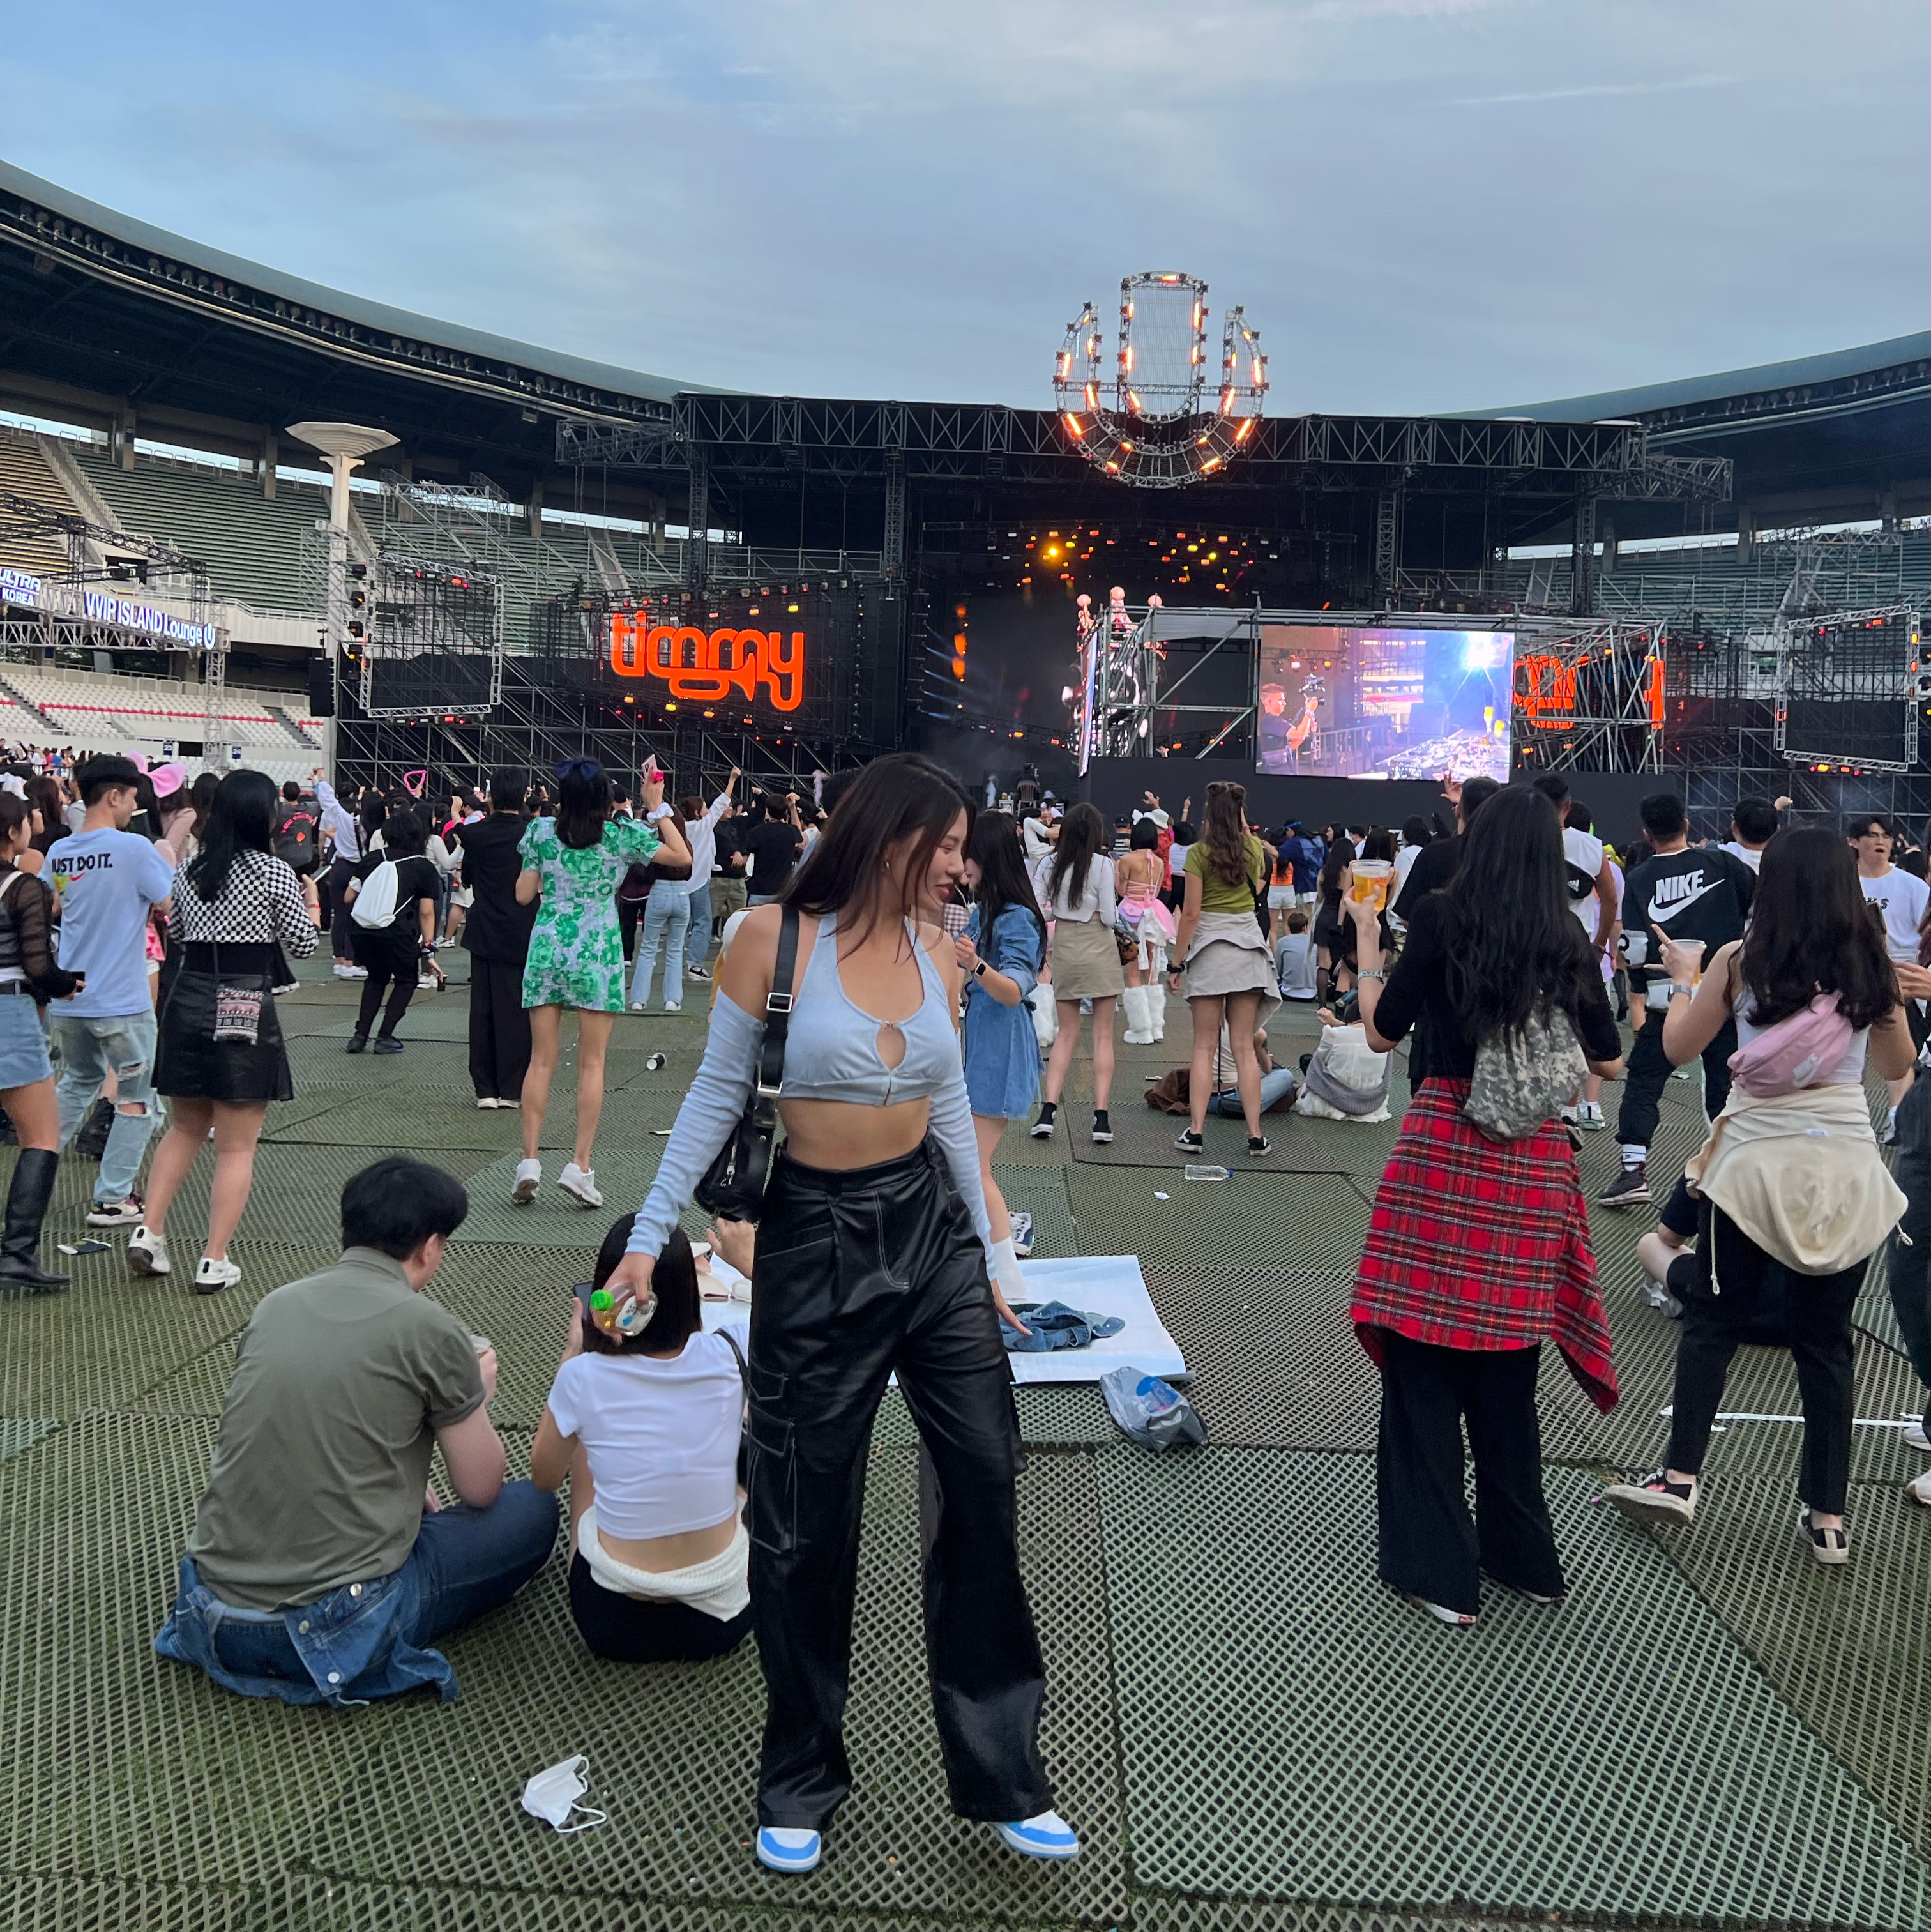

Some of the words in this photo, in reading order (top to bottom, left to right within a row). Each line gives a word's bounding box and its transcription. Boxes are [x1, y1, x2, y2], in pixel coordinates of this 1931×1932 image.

[0, 567, 42, 592] ULTRA
[2, 587, 34, 607] KOREA
[86, 591, 116, 621] VVIP
[117, 600, 163, 634] ISLAND
[164, 612, 202, 647] Lounge
[610, 609, 805, 711] timmy
[52, 857, 74, 874] JUST
[77, 855, 95, 871] DO
[98, 853, 113, 869] IT.
[1655, 869, 1704, 905] NIKE
